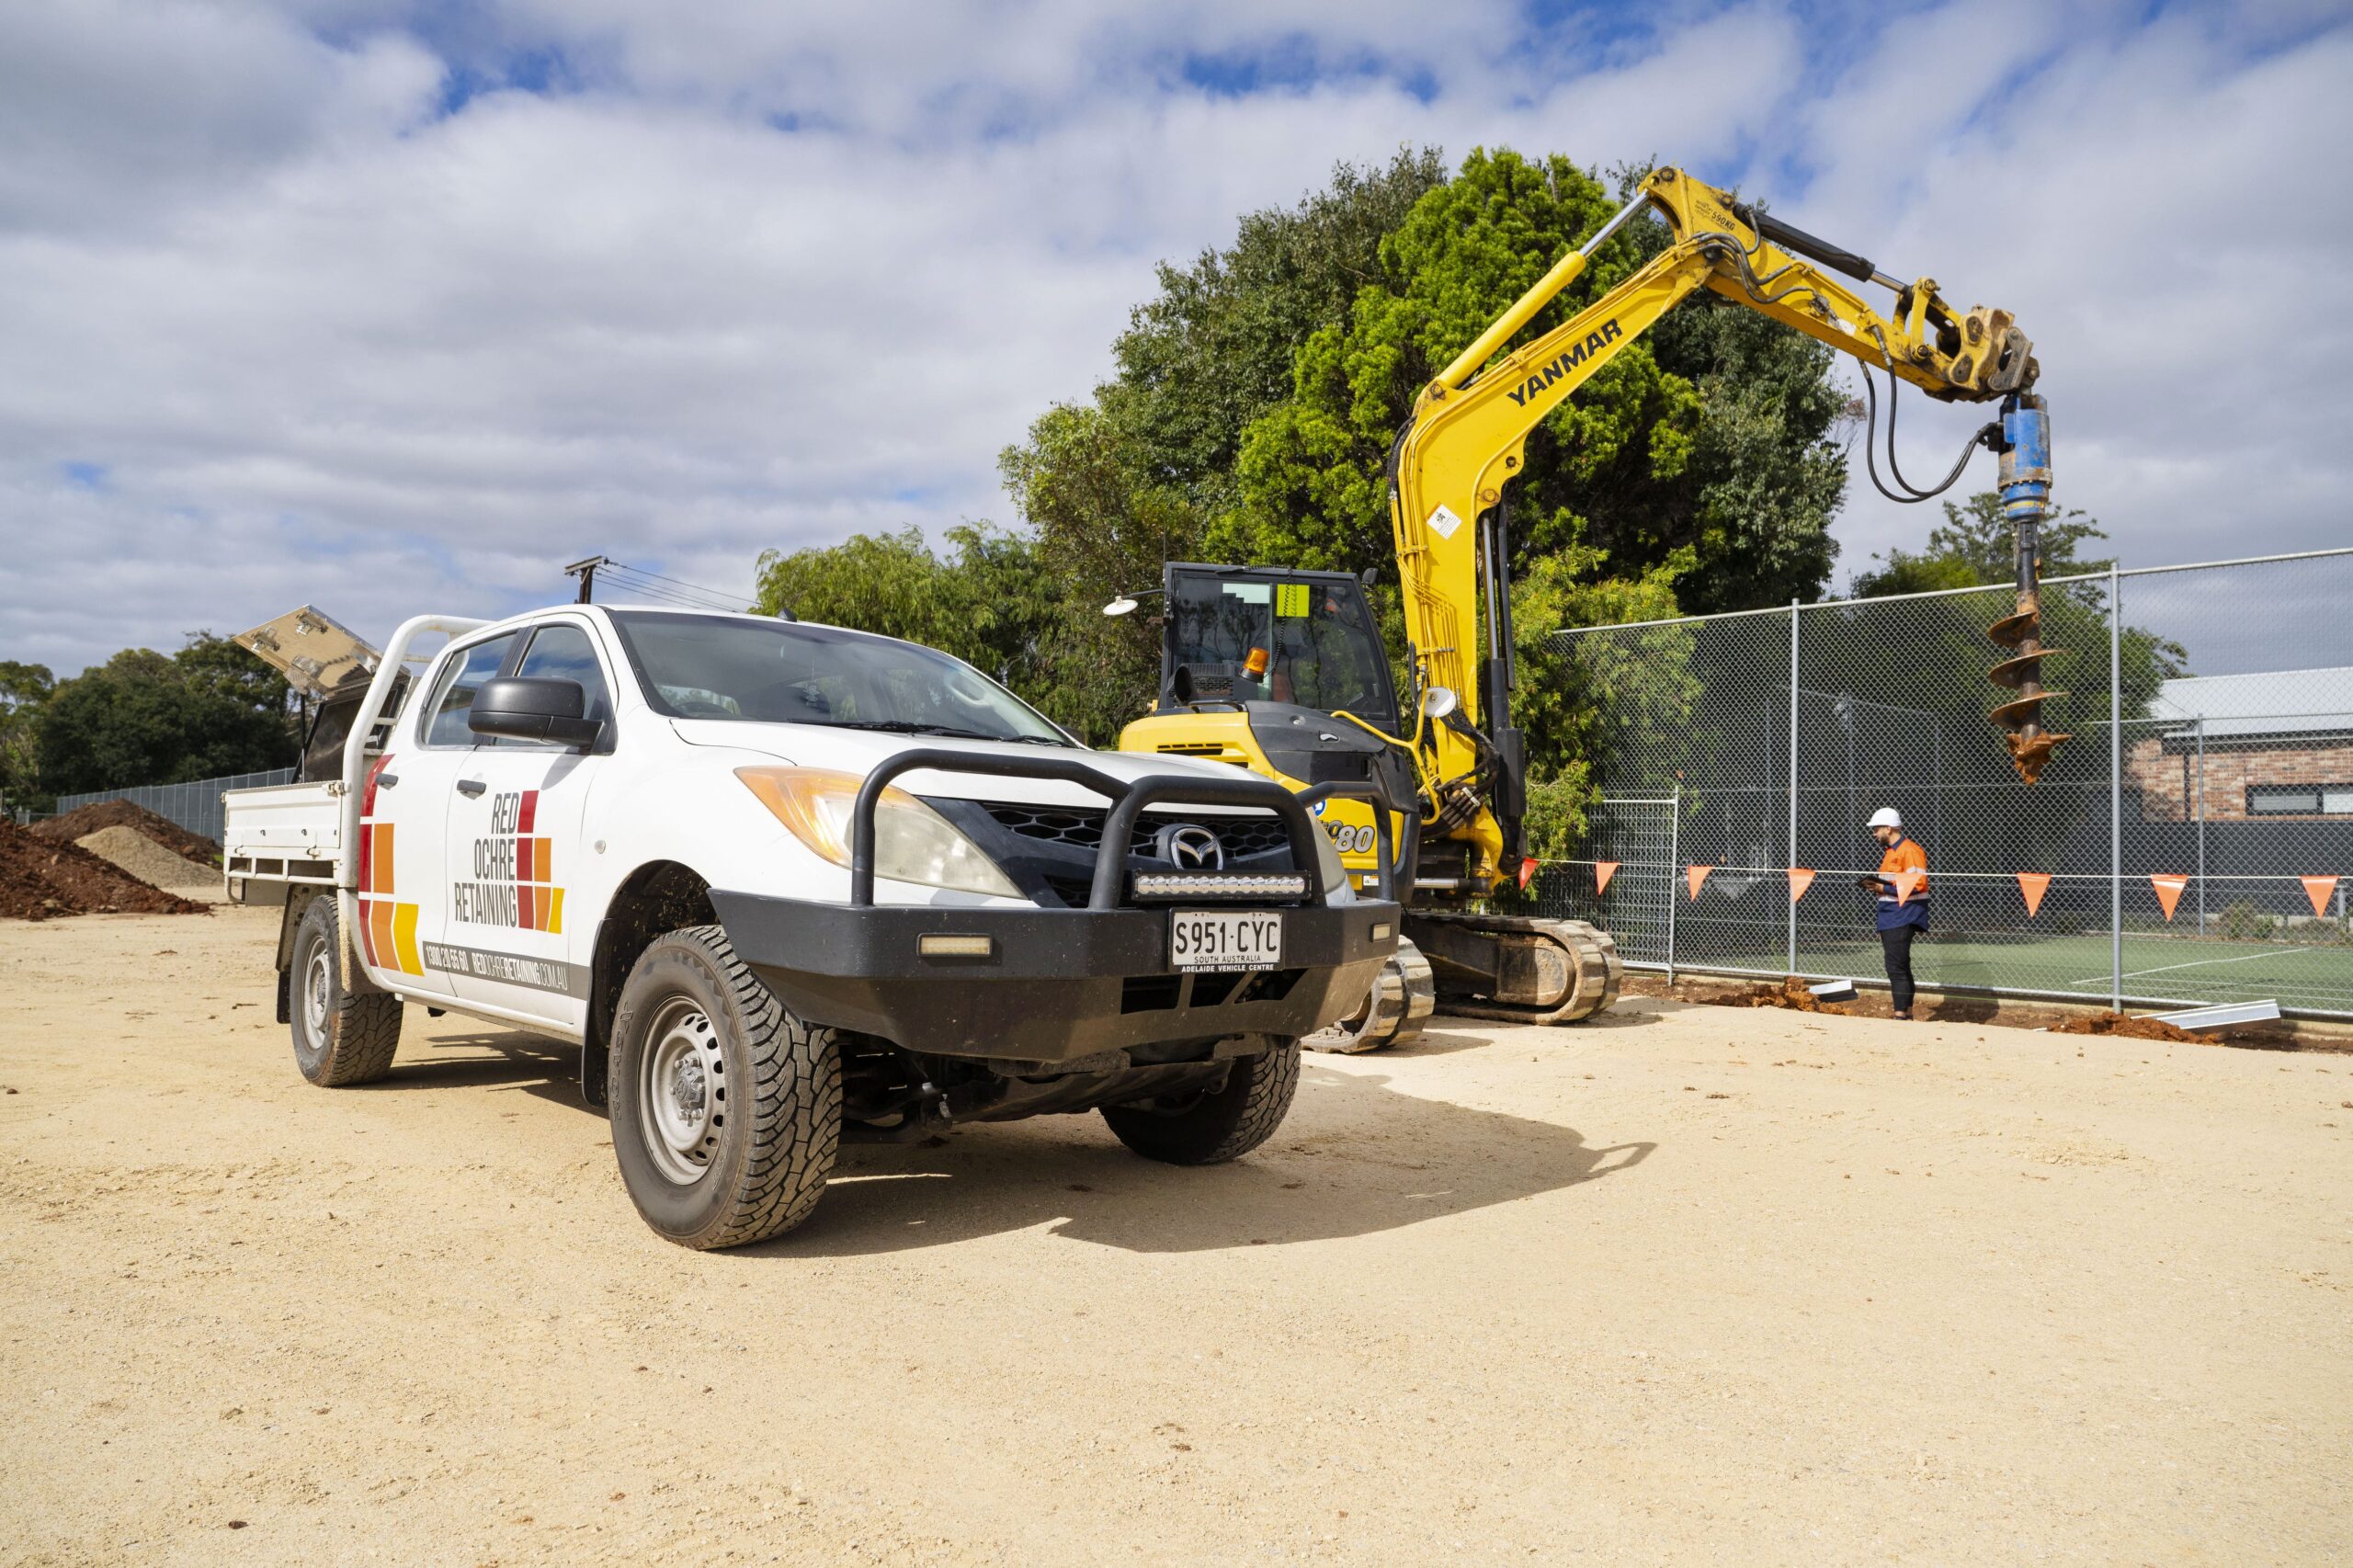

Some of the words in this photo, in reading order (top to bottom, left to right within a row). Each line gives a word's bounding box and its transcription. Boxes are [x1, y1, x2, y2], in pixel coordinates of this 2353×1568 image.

[1711, 211, 1735, 231] 590KG
[1506, 318, 1623, 407] YANMAR
[491, 792, 519, 835] RED
[474, 838, 516, 881] OCHRE
[454, 881, 517, 928] RETAINING
[426, 945, 442, 967] 1300
[441, 947, 451, 968] 20
[449, 949, 460, 970] 55
[459, 949, 470, 971] 60
[472, 952, 568, 991] REDOCHRERETAINING.COM.AU
[1181, 964, 1214, 972] ADELAIDE
[1194, 956, 1220, 964] SOUTH
[1222, 955, 1261, 963] AUSTRALIA
